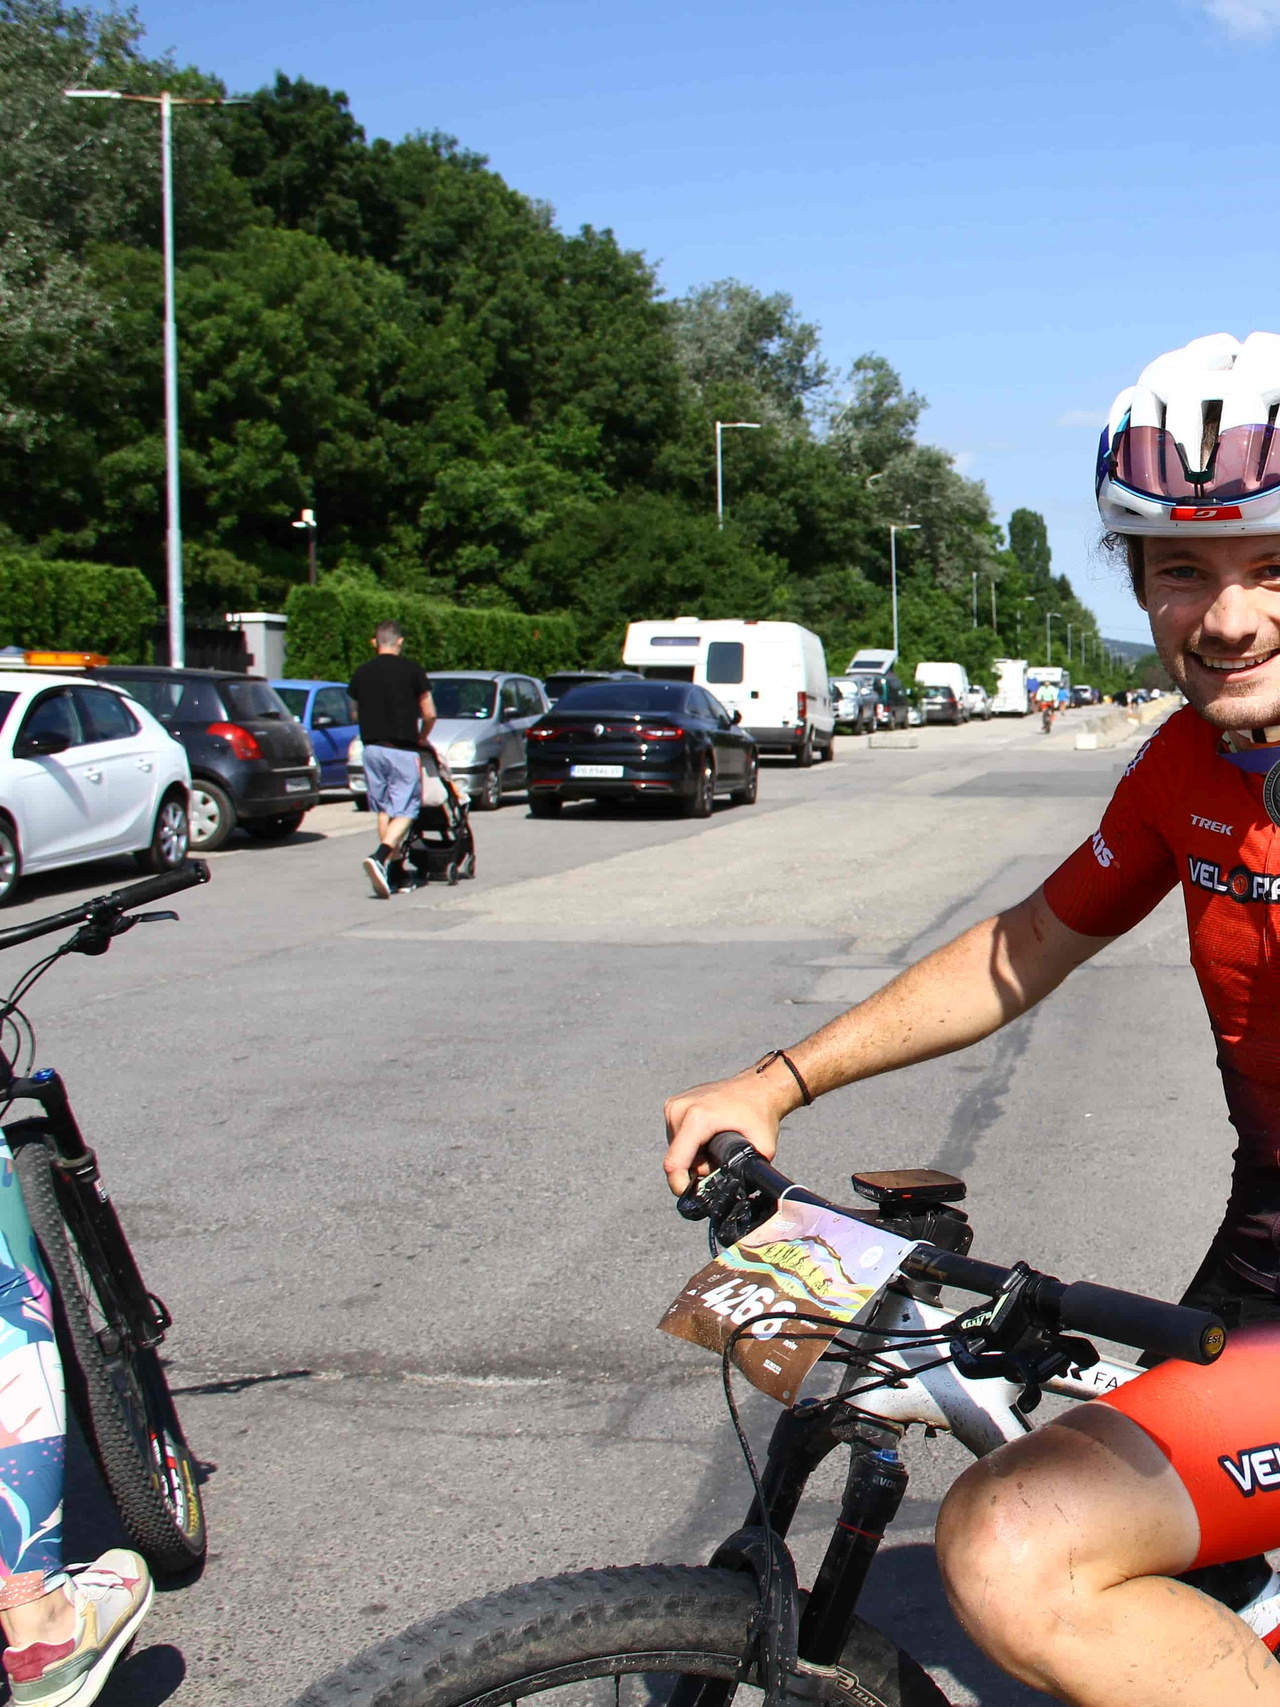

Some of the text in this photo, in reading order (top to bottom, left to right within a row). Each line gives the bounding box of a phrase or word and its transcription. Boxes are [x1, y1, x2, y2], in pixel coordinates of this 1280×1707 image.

[1190, 814, 1234, 837] TREK
[700, 1277, 797, 1340] 4268
[1207, 1334, 1221, 1345] ESI
